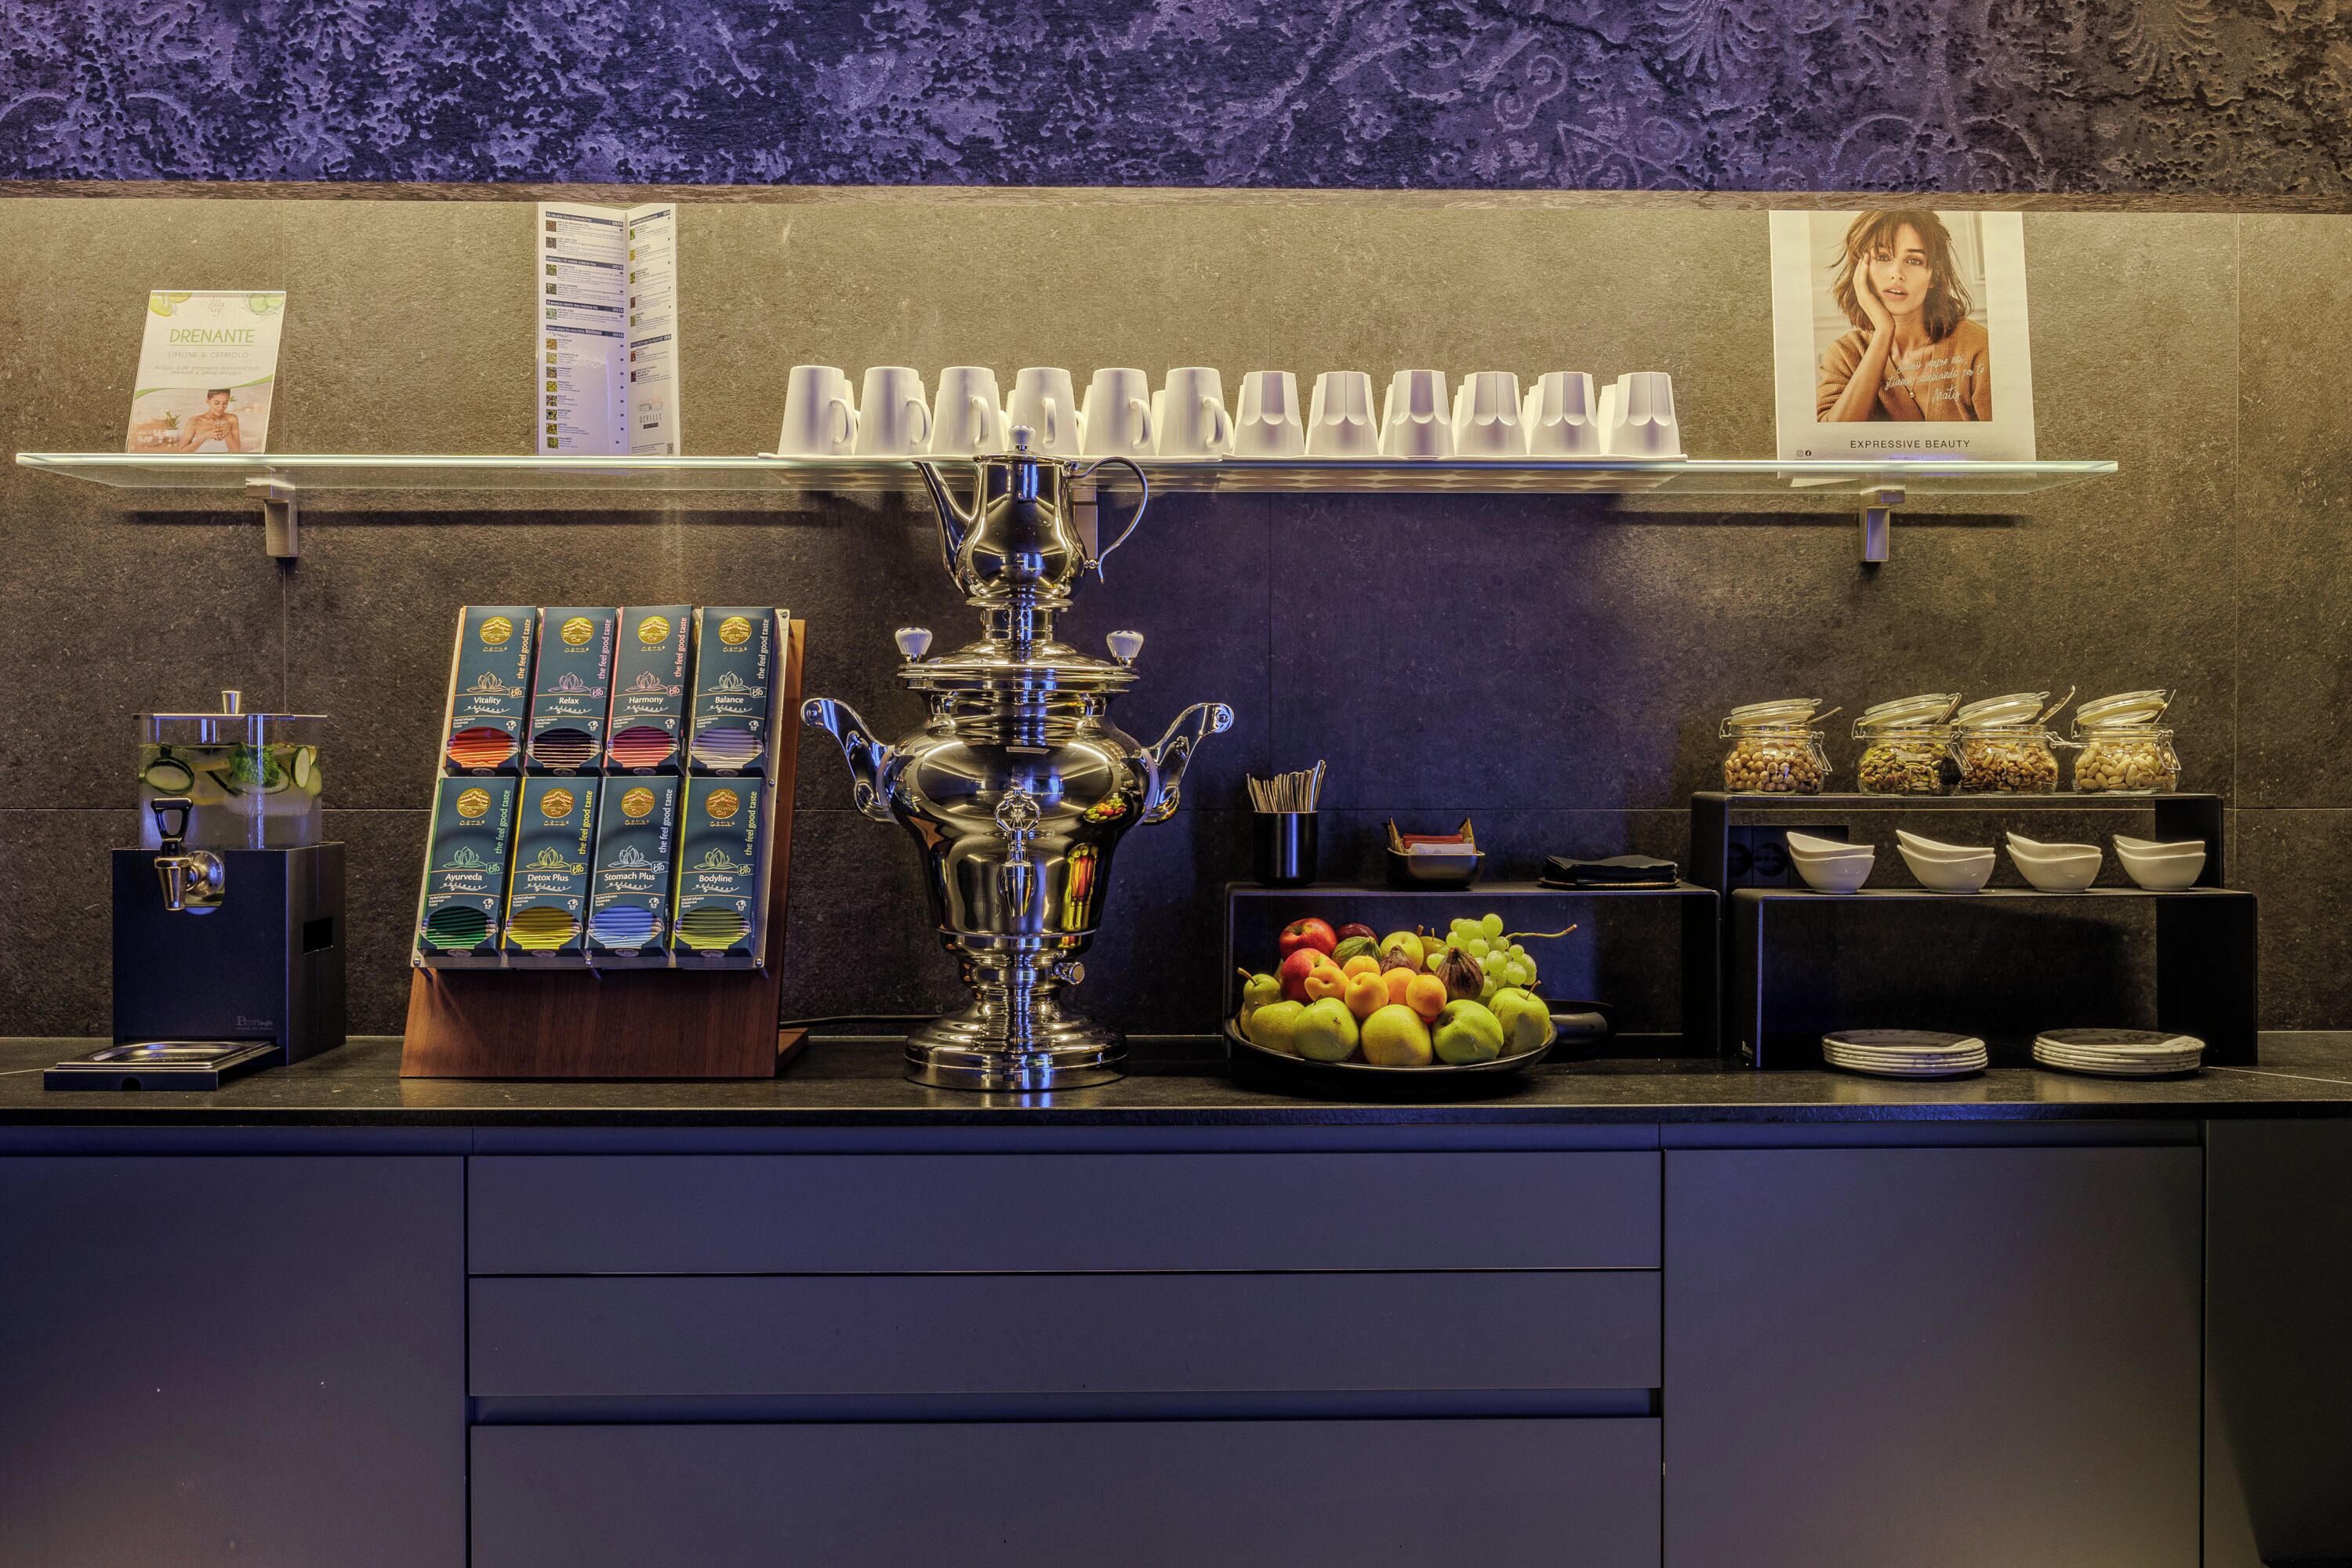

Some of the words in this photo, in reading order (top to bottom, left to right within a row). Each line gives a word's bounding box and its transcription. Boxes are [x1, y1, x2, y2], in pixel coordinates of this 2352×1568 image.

[169, 329, 255, 343] DRENANTE
[760, 636, 768, 654] good
[518, 654, 527, 666] feel
[599, 655, 607, 666] feel
[675, 653, 683, 665] feel
[758, 654, 766, 666] feel
[517, 668, 525, 679] the
[597, 668, 606, 679] the
[674, 666, 682, 677] the
[511, 688, 522, 697] bio
[592, 688, 603, 697] bio
[669, 686, 680, 695] bio
[753, 688, 763, 697] bio
[474, 697, 501, 705] Vitality
[500, 809, 508, 827] good
[663, 808, 671, 826] good
[748, 810, 756, 828] good
[496, 828, 505, 840] feel
[579, 829, 588, 841] feel
[660, 827, 668, 839] feel
[745, 830, 754, 842] feel
[495, 842, 503, 854] the
[578, 842, 586, 854] the
[658, 841, 667, 853] the
[744, 844, 752, 855] the
[489, 864, 500, 873] bio
[572, 865, 584, 874] bio
[653, 863, 664, 872] bio
[739, 865, 751, 874] bio
[445, 873, 482, 882] Ayurveda
[604, 872, 637, 881] Stomach
[699, 875, 732, 883] Bodyline
